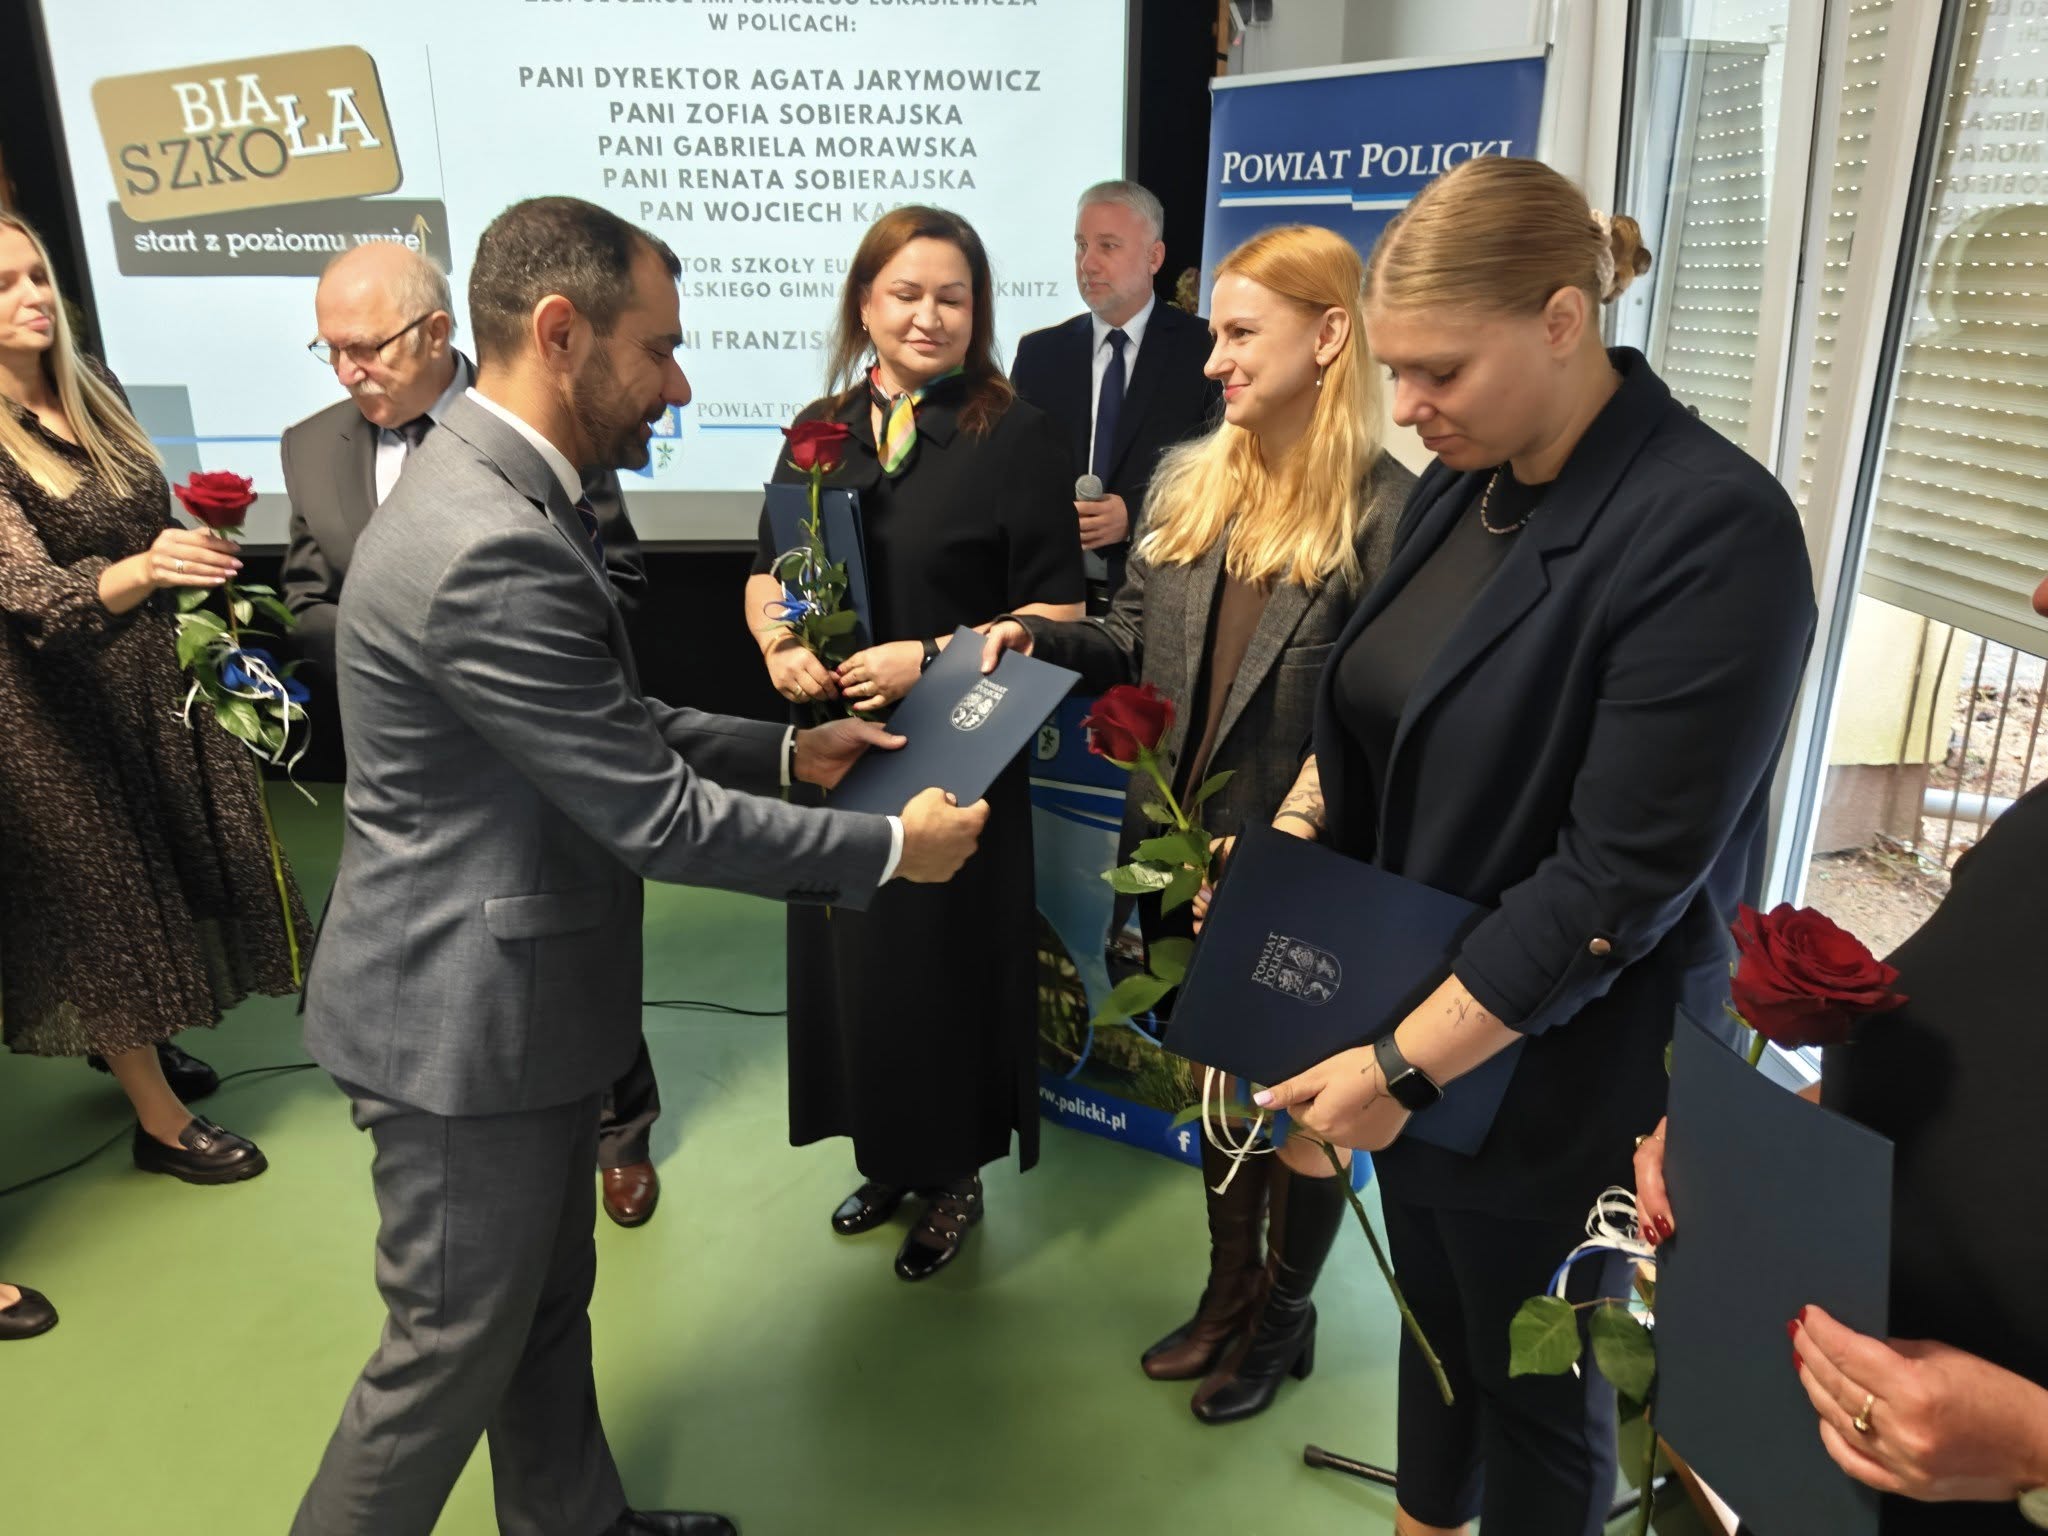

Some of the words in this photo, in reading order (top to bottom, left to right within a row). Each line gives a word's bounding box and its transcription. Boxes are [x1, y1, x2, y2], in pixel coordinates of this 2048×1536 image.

[707, 13, 728, 31] W
[737, 13, 857, 33] POLICACH:
[519, 66, 584, 89] PANI
[594, 66, 741, 91] DYREKTOR
[750, 68, 845, 91] AGATA
[853, 69, 1041, 92] JARYMOWICZ
[609, 101, 675, 124] PANI
[686, 103, 769, 125] ZOFIA
[779, 103, 963, 125] SOBIERAJSKA
[598, 135, 663, 156] PANI
[673, 135, 806, 157] GABRIELA
[815, 136, 978, 158] MORAWSKA
[1220, 150, 1352, 185] POWIAT
[603, 168, 668, 189] PANI
[678, 168, 785, 190] RENATA
[794, 169, 977, 190] SOBIERAJSKA
[639, 201, 694, 222] PAN
[703, 201, 842, 223] WOJCIECH
[134, 229, 198, 253] start
[205, 232, 220, 252] z
[227, 228, 347, 258] poziomu
[731, 257, 815, 274] SZKOŁY
[681, 281, 771, 298] LSKIEGO
[779, 281, 834, 298] GIMN
[997, 281, 1059, 297] KNITZ
[712, 330, 826, 350] FRANZIS
[697, 402, 775, 418] POWIAT
[1251, 931, 1279, 983] POWIAT
[1261, 935, 1290, 989] POLICKI
